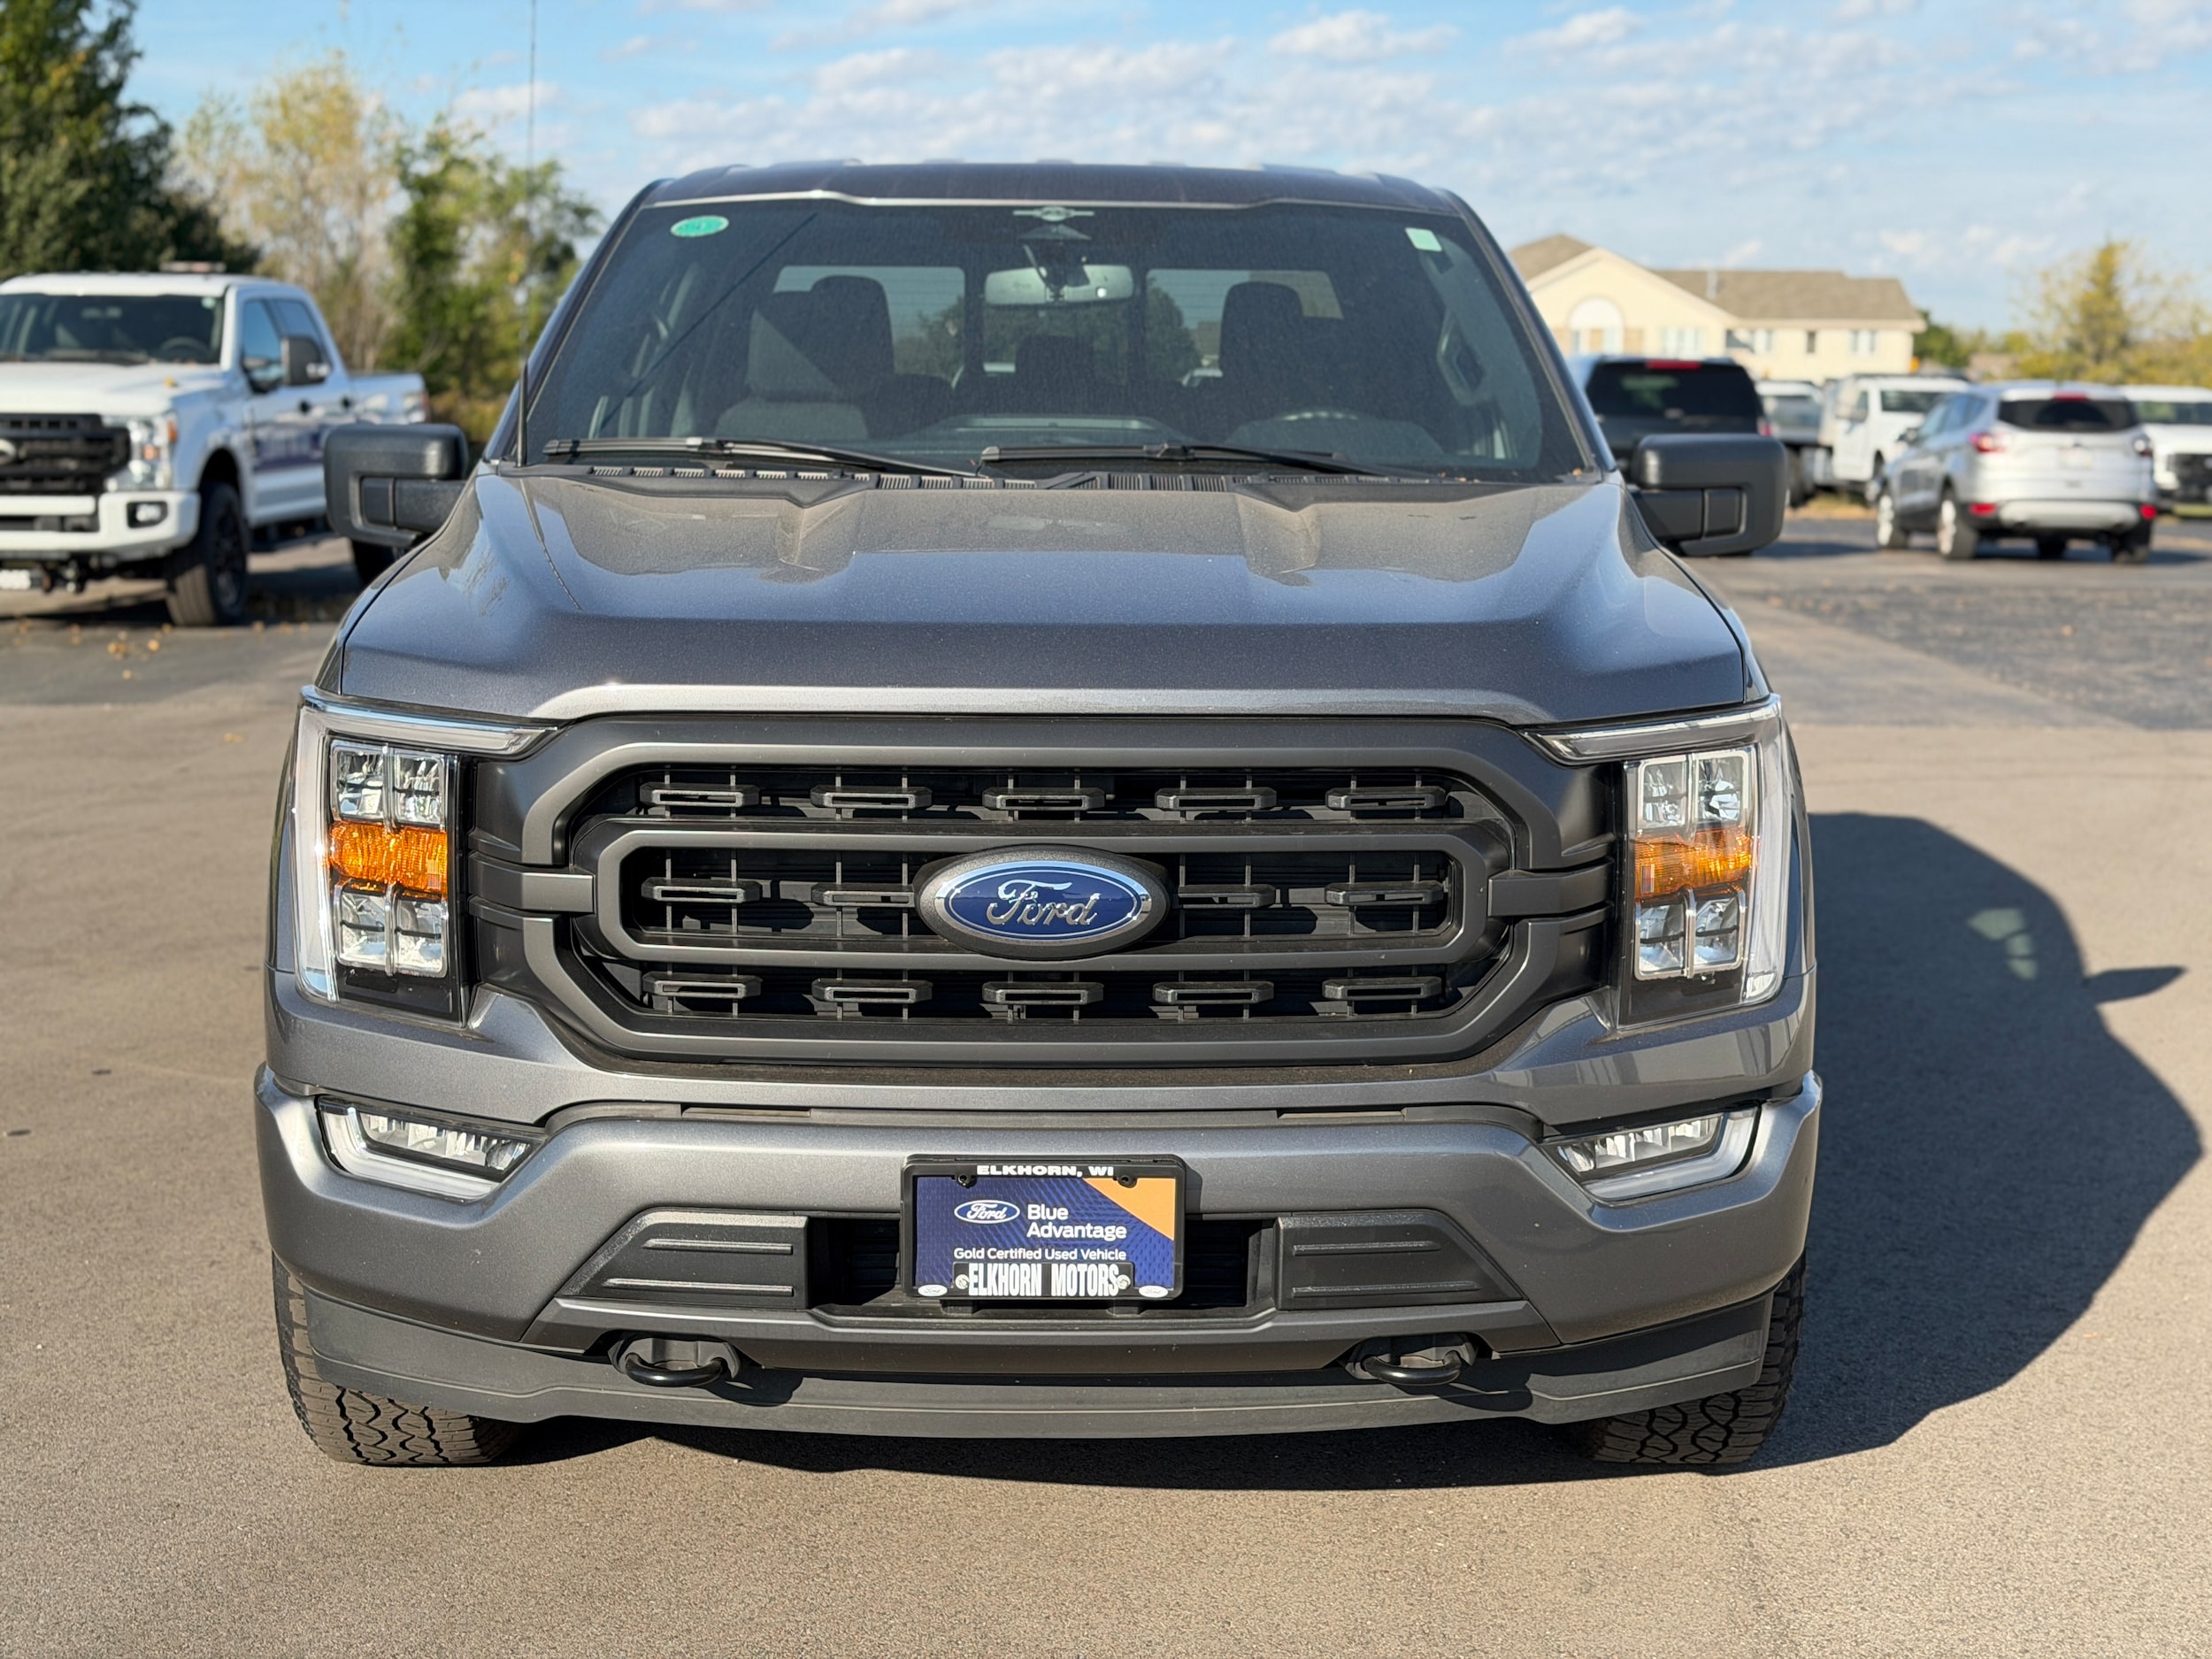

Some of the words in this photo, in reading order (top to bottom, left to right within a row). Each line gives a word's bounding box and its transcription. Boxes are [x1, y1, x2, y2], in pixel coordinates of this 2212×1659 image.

[986, 879, 1102, 926] Ford
[976, 1164, 1083, 1178] ELKHORN,
[1088, 1165, 1115, 1177] WI
[966, 1202, 1009, 1220] Ford
[1026, 1203, 1069, 1220] Blue
[1026, 1222, 1127, 1242] Advantage
[953, 1247, 985, 1260] Gold
[987, 1247, 1042, 1260] Certified
[1044, 1248, 1078, 1260] Used
[1079, 1248, 1127, 1261] Vehicle
[968, 1263, 1042, 1296] ELKHORN
[1050, 1263, 1120, 1297] MOTORS
